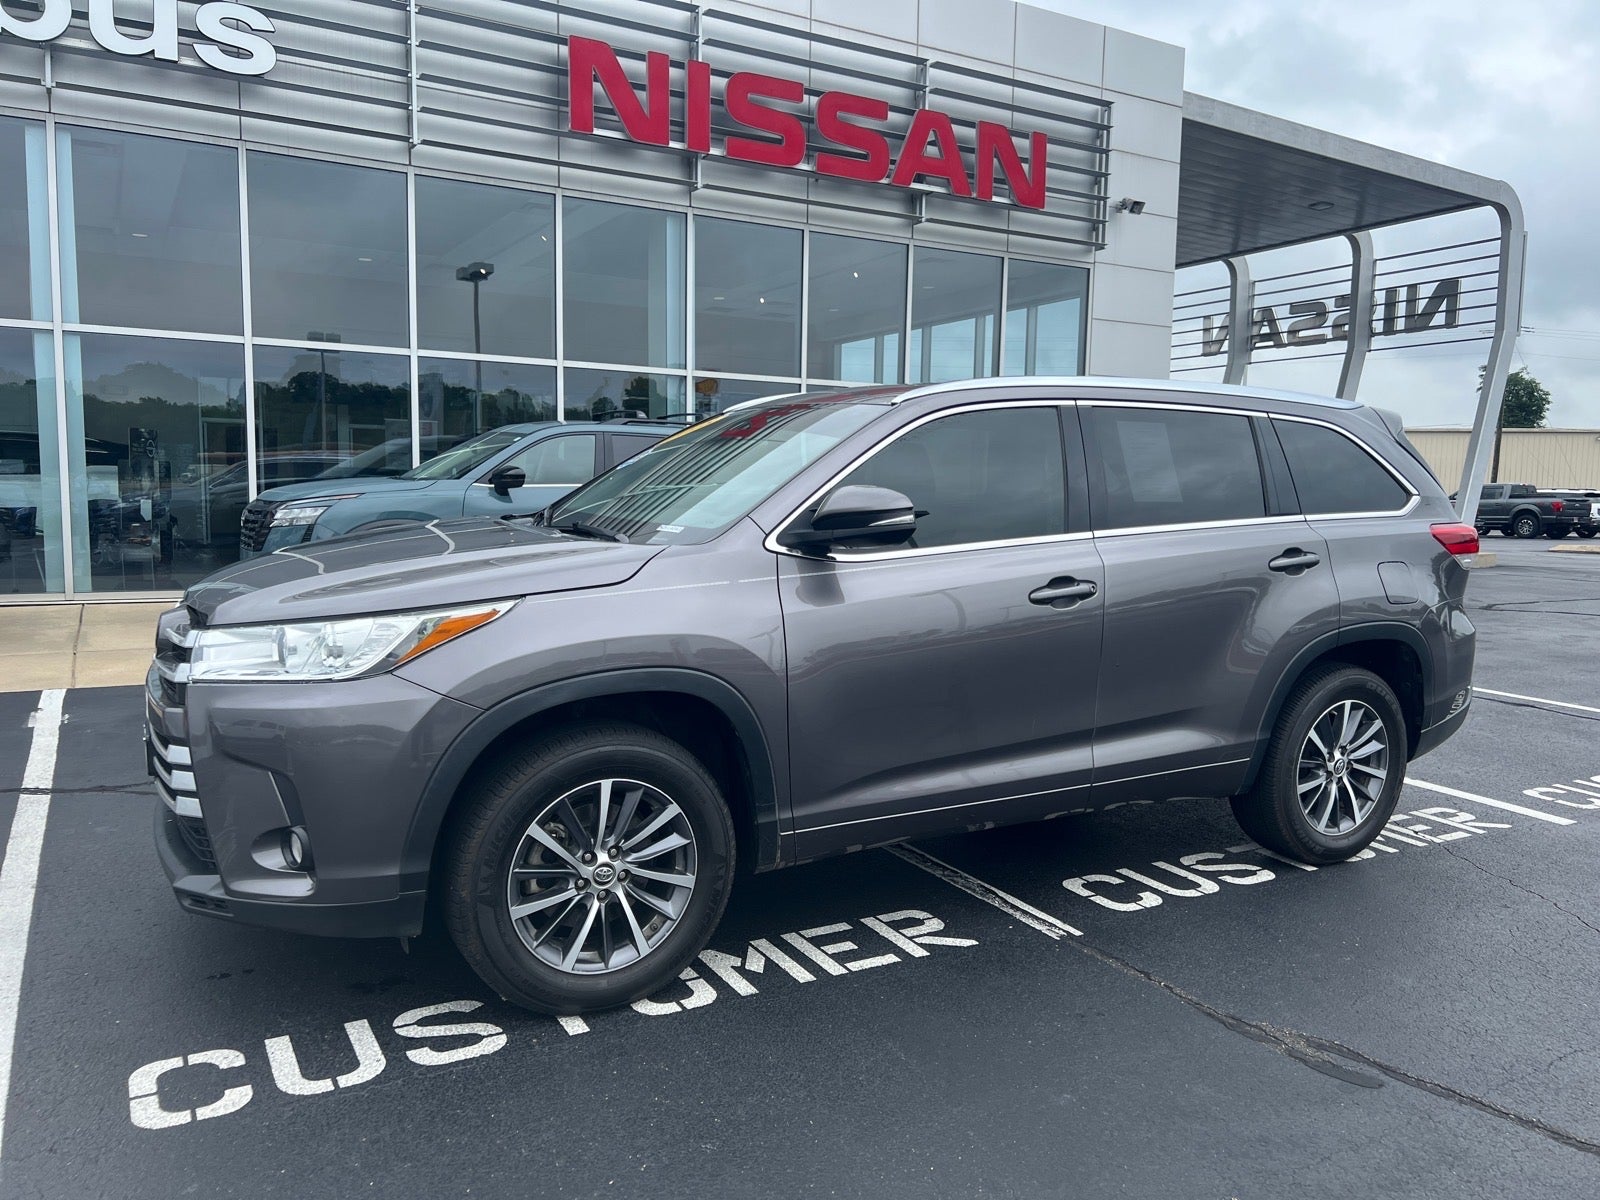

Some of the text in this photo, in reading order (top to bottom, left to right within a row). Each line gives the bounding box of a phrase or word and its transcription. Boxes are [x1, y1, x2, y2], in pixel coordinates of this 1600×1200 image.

[568, 35, 1047, 210] NISSAN
[1062, 807, 1513, 911] CUSTER
[1522, 774, 1600, 809] CU
[128, 909, 980, 1130] CUSMER
